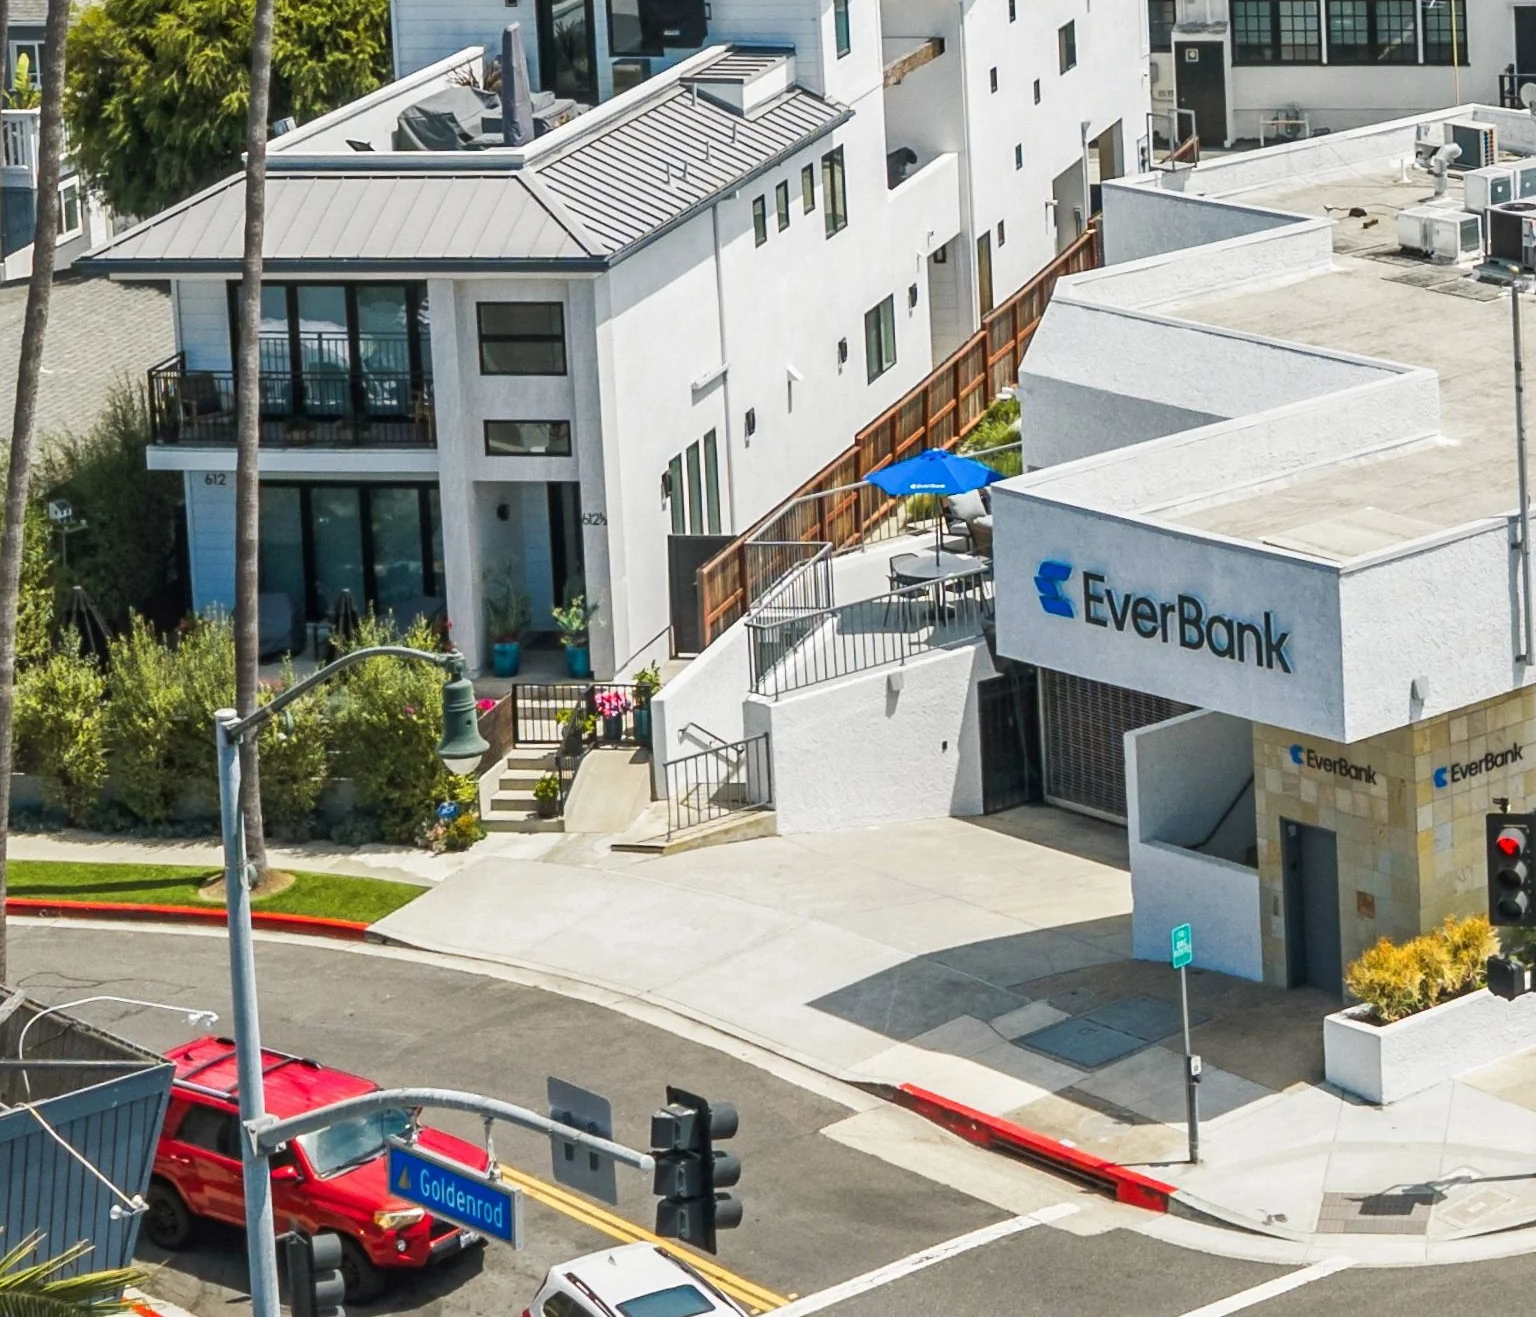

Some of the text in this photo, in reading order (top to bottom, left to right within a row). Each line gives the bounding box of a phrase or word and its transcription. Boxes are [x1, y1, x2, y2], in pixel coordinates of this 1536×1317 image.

[205, 473, 227, 485] 612
[1082, 570, 1293, 674] EverBank
[1306, 749, 1377, 785] EverBank
[1450, 742, 1524, 783] EverBank
[420, 1168, 503, 1229] Goldenrod
